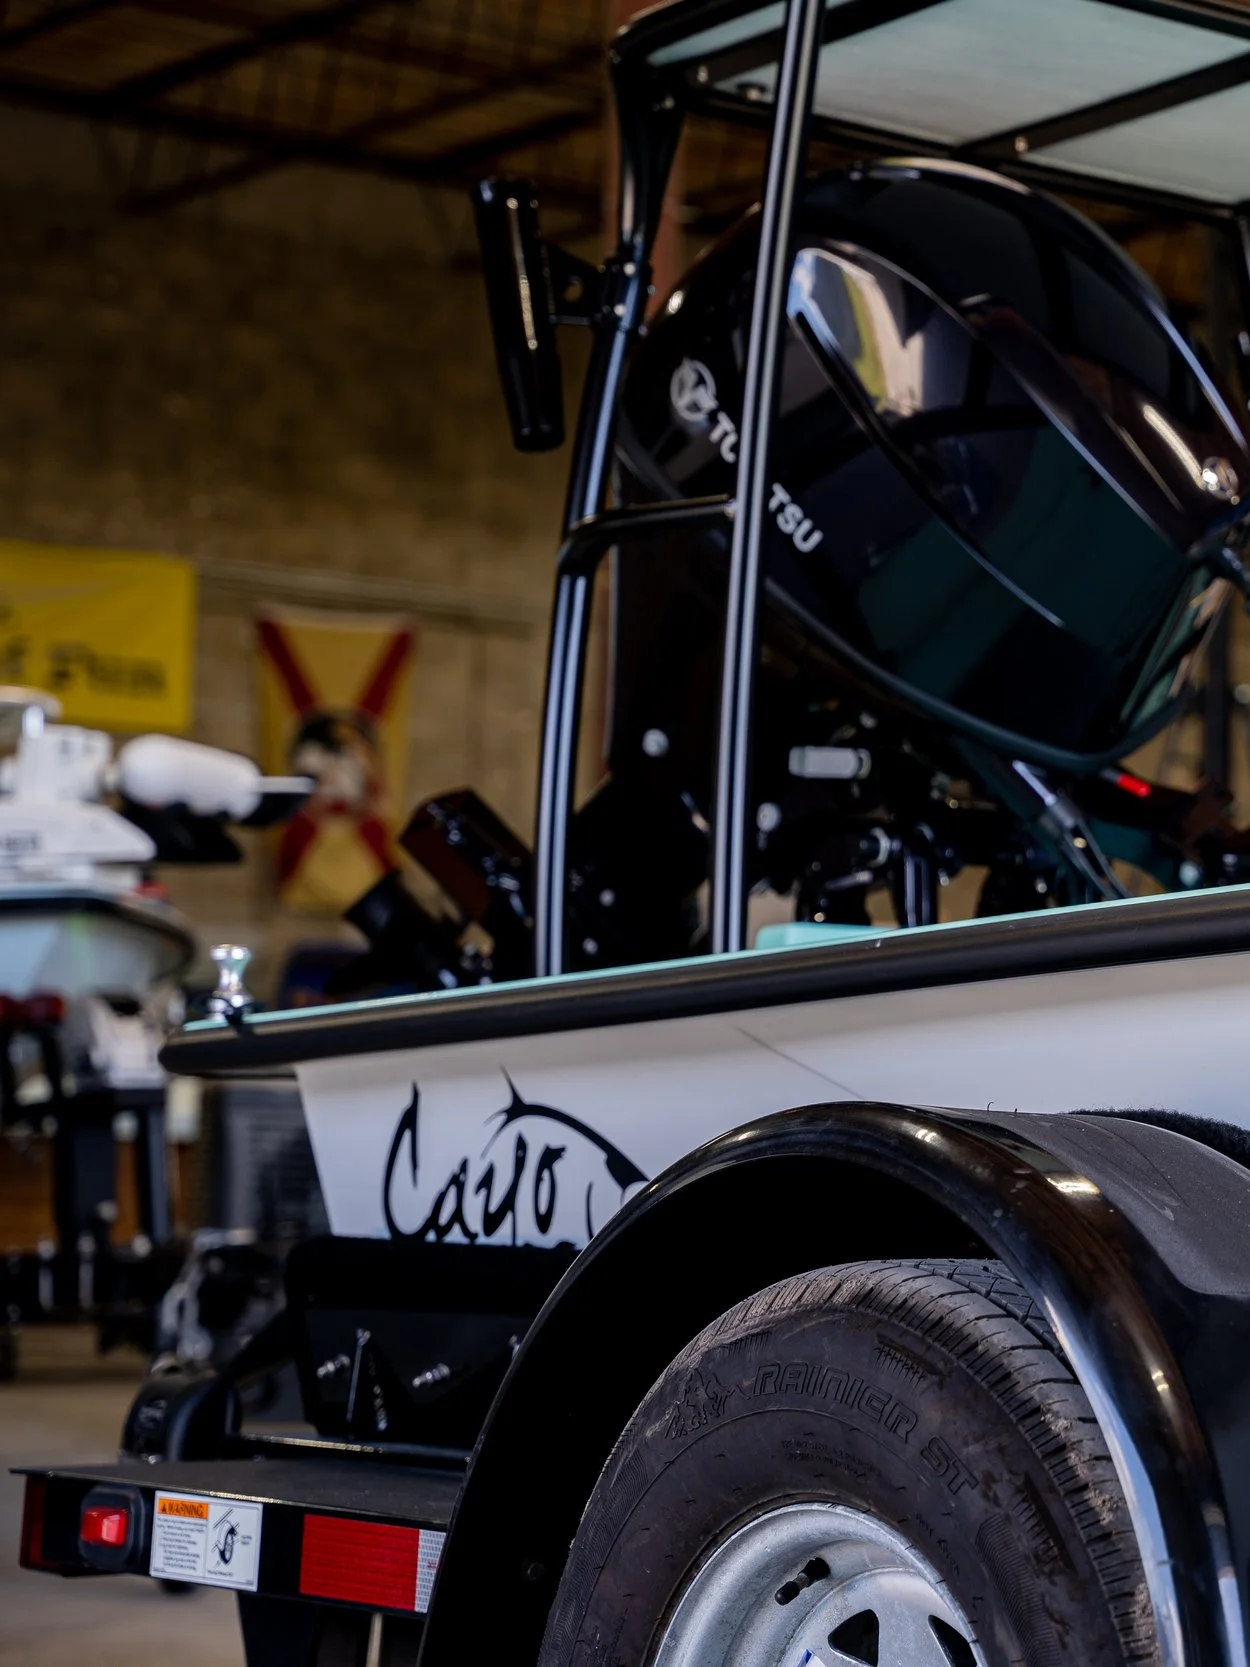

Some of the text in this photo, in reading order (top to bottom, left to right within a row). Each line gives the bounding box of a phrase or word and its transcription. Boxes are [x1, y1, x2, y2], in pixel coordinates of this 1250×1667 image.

[383, 1081, 567, 1247] Cayo
[753, 1361, 918, 1443] RAINIER
[920, 1436, 979, 1496] ST
[169, 1501, 204, 1518] WARNING
